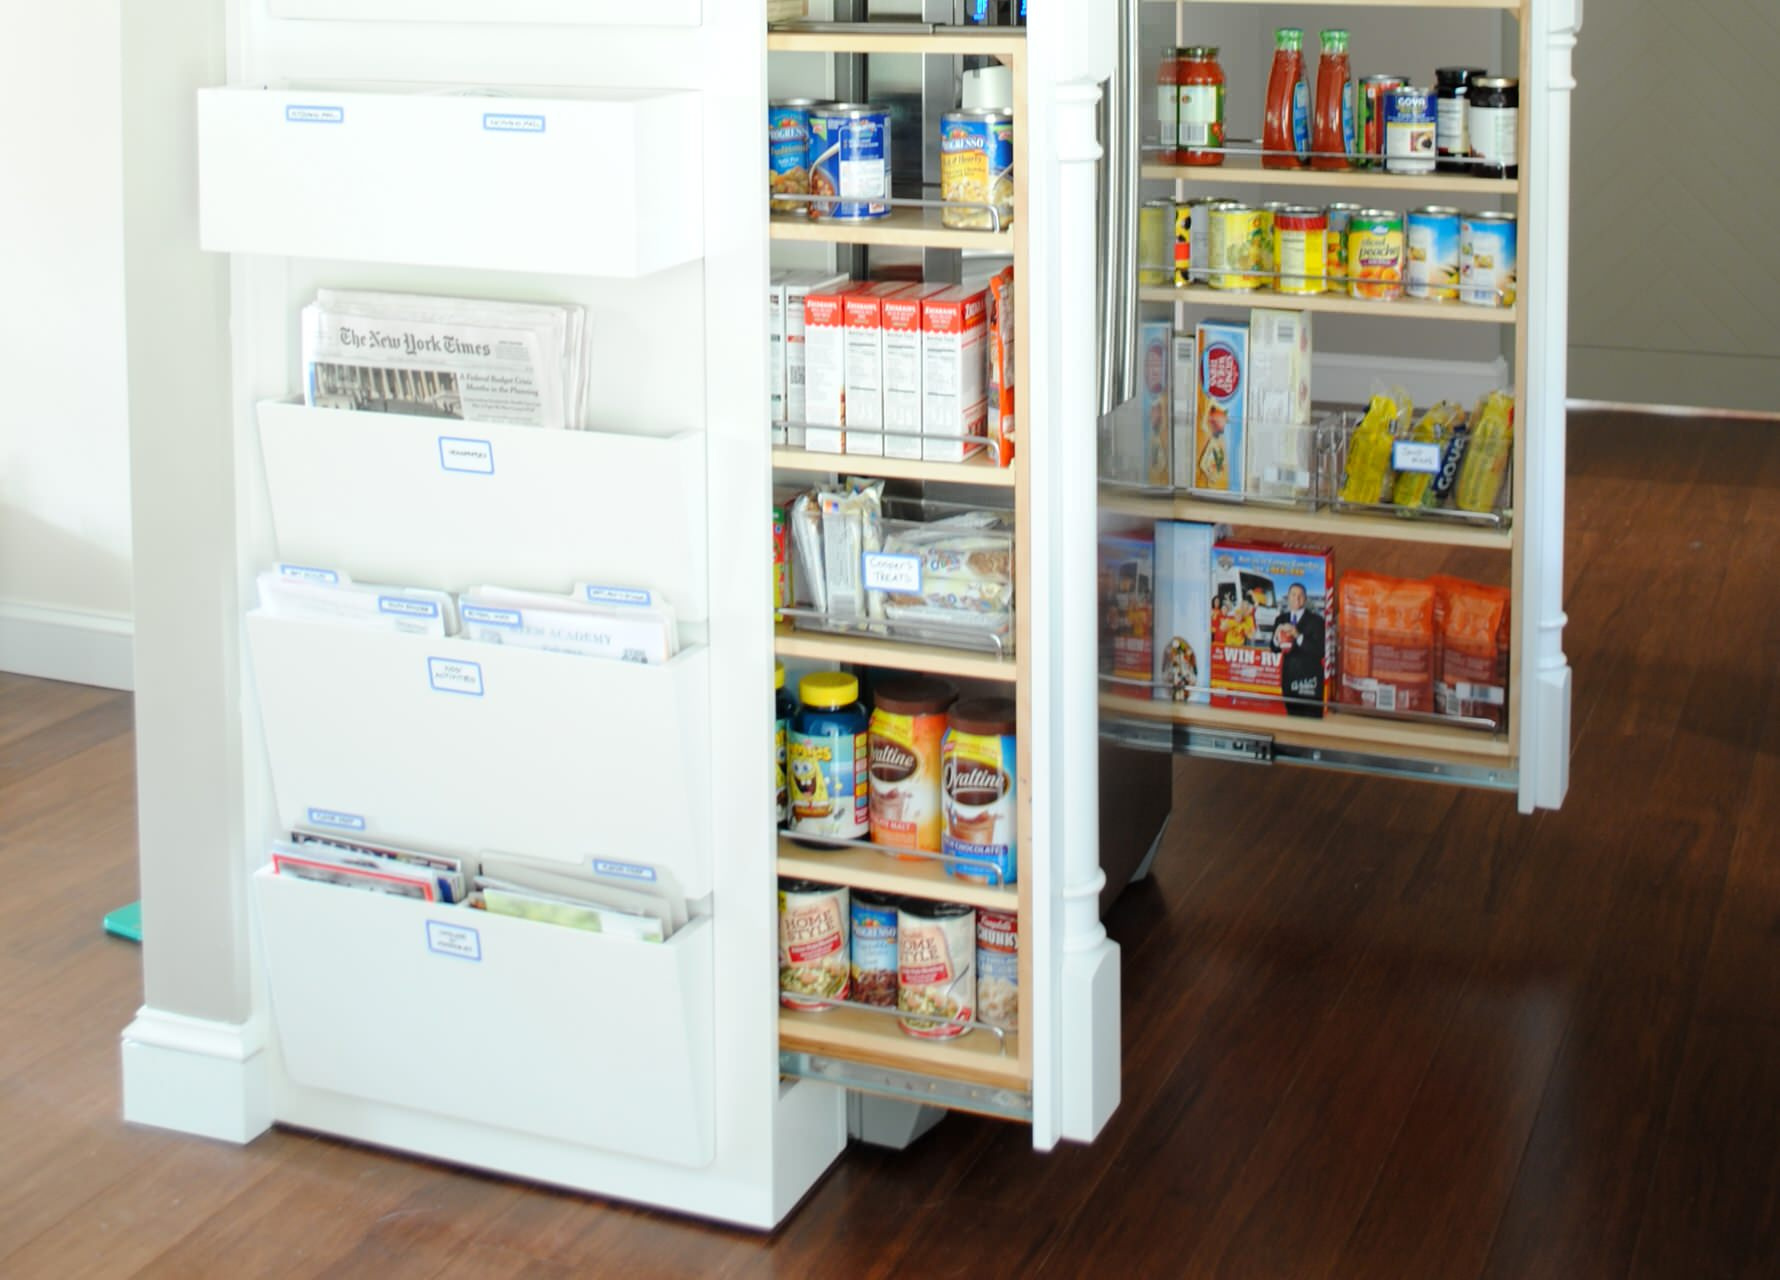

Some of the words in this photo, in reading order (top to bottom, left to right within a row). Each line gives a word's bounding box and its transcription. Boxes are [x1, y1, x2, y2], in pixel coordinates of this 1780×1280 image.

[340, 327, 367, 348] The
[368, 330, 401, 349] New
[403, 332, 443, 356] York
[443, 335, 492, 357] Times
[549, 627, 613, 646] ACADEMY
[1224, 646, 1255, 664] WIN
[871, 745, 914, 767] valtine
[944, 763, 1005, 790] Ovaltine
[785, 910, 833, 929] HOME
[787, 923, 834, 941] STYLE
